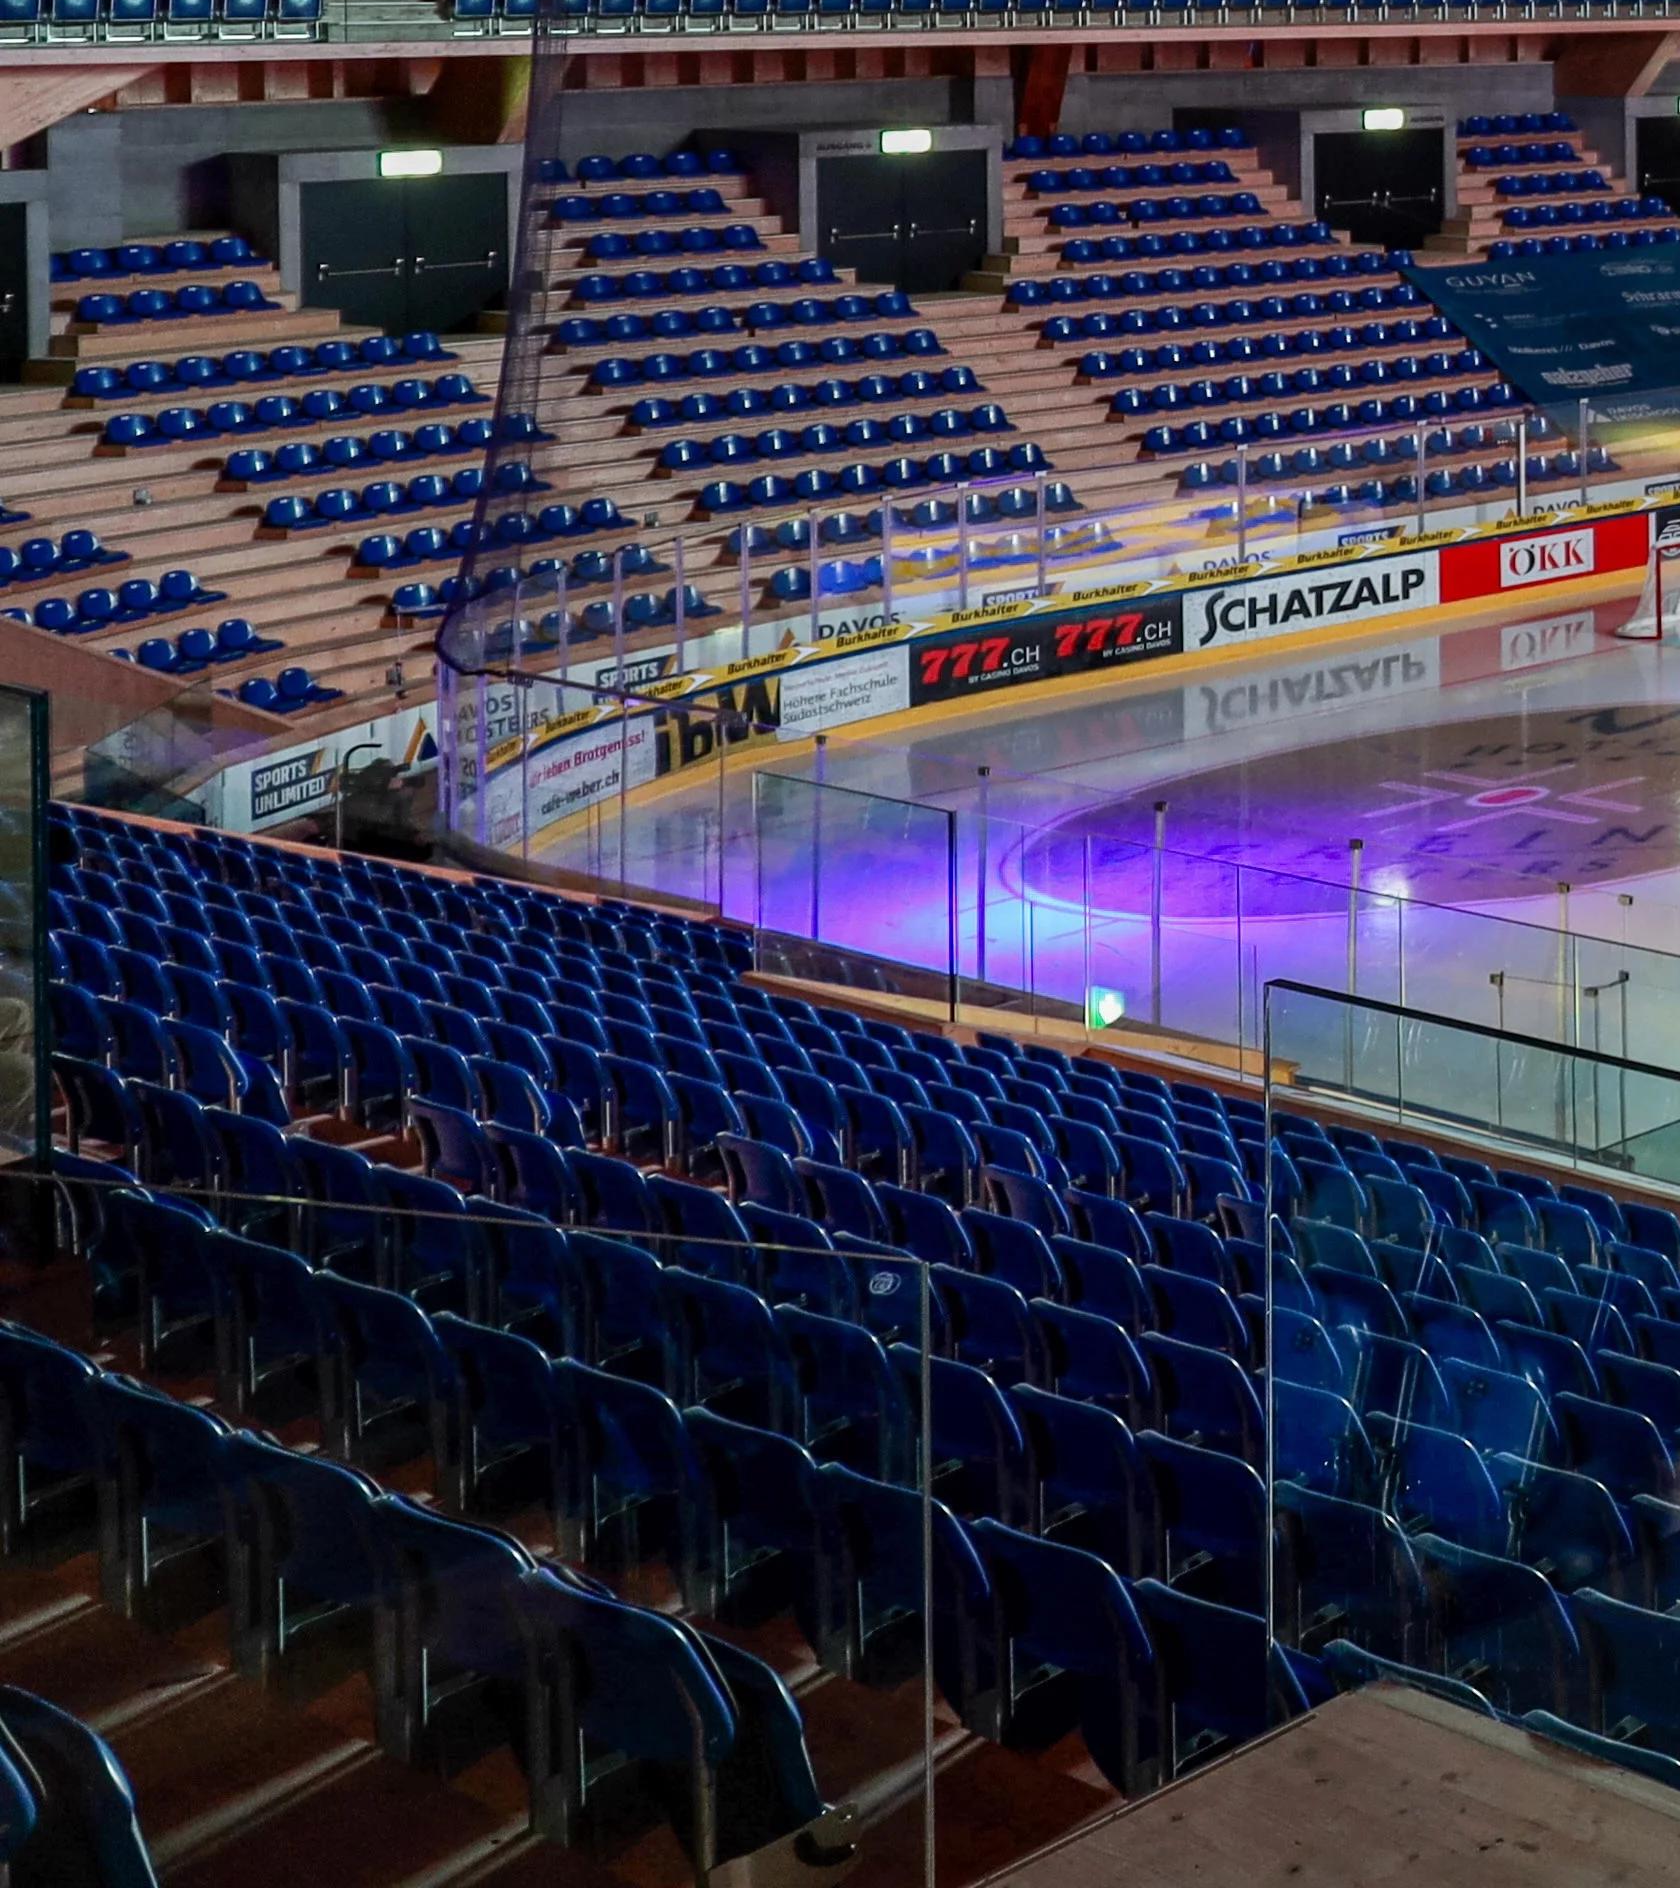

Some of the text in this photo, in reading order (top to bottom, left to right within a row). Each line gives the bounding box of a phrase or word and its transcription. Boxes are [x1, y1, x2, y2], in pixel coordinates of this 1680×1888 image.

[1446, 271, 1536, 288] GUYAN
[1586, 499, 1636, 515] Burkhalter
[1508, 538, 1584, 576] ÖKK
[1188, 563, 1250, 583] Burkhalter
[1072, 582, 1138, 601] Burkhalter
[951, 603, 1019, 623] Burkhalter
[1199, 569, 1425, 647] SCHATZALP
[818, 612, 899, 639] DAVOS
[835, 626, 899, 648] Burkhalter
[1055, 614, 1172, 657] 777.CH
[1115, 644, 1144, 656] CASINO
[1146, 639, 1172, 650] DAVOS
[727, 650, 788, 674] Burkhalter
[921, 637, 1040, 685] 777.CH
[1014, 664, 1039, 676] DAVOS
[600, 661, 659, 686] SPORTS
[829, 674, 898, 700] Fachschule
[254, 759, 307, 792] SPORTS
[254, 775, 326, 814] UNLIMITED
